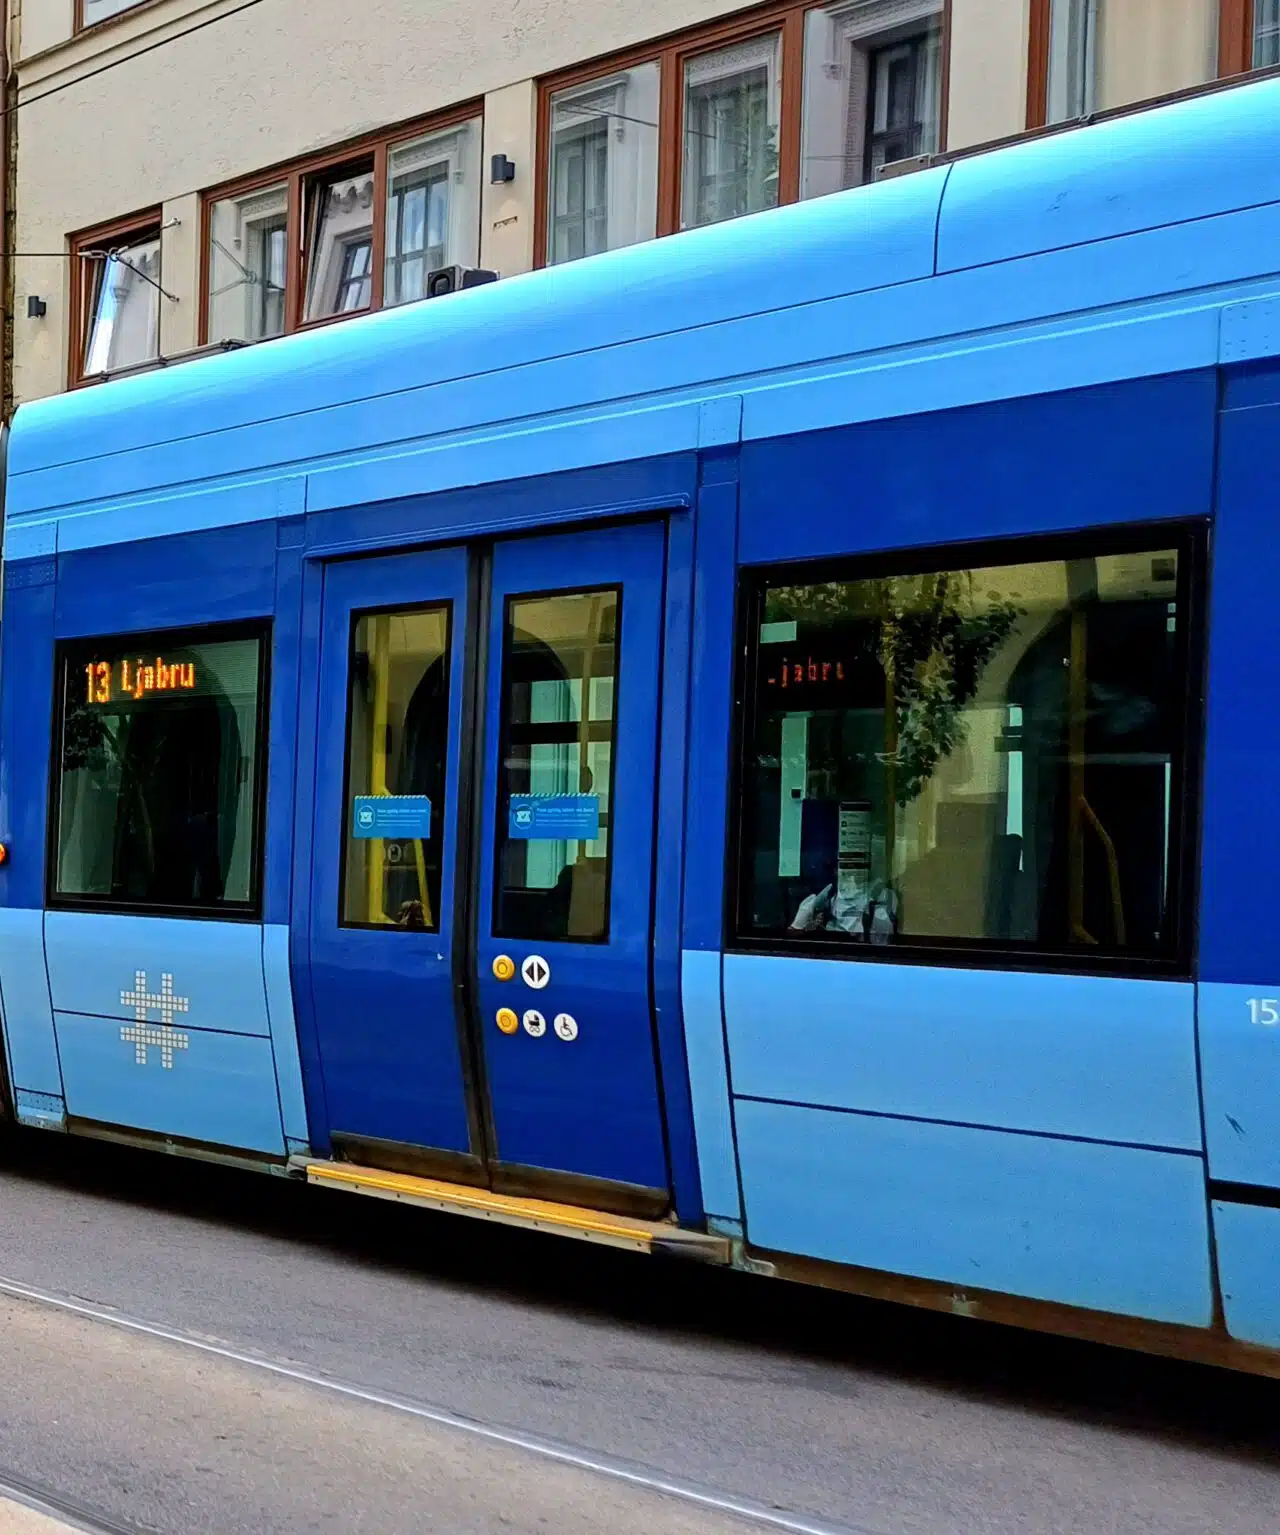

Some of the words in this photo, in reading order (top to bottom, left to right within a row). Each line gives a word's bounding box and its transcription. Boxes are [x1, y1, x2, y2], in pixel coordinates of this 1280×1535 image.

[85, 661, 111, 703] 13
[121, 657, 196, 699] Ljabru
[1245, 998, 1279, 1025] 15
